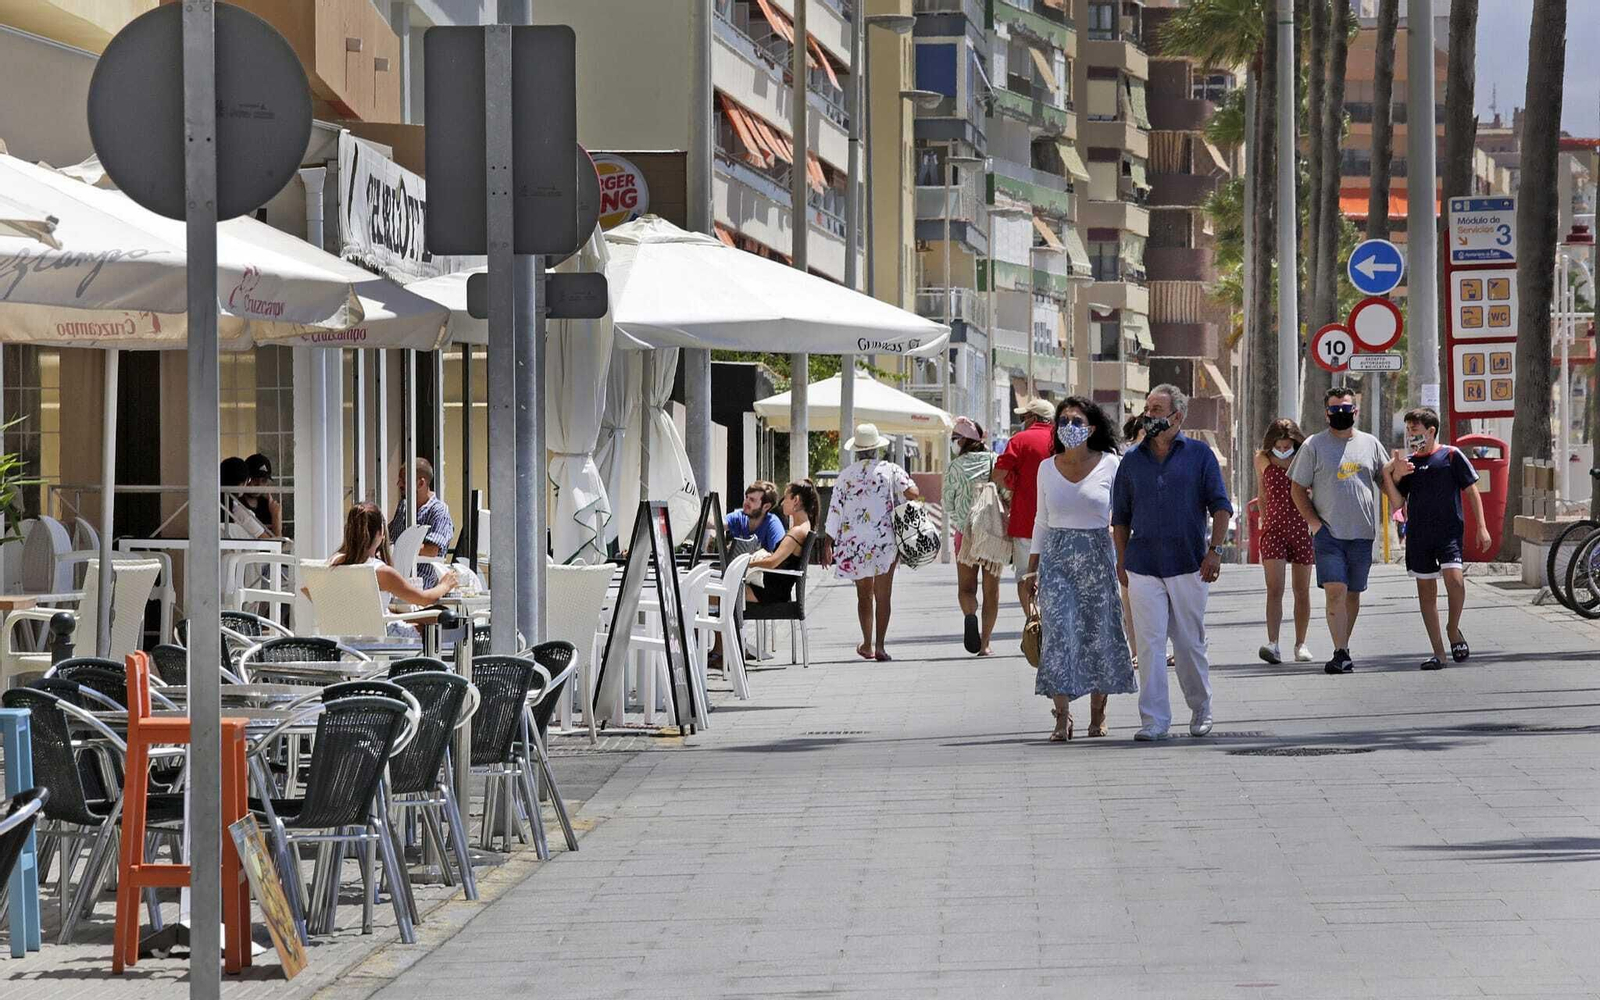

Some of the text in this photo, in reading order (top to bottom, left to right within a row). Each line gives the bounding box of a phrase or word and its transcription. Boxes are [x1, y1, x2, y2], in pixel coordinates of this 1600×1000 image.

[1457, 216, 1500, 225] Módulo de
[1457, 226, 1494, 234] Servicios
[1496, 224, 1512, 246] 3
[1491, 312, 1507, 321] WC
[1325, 340, 1346, 355] 10
